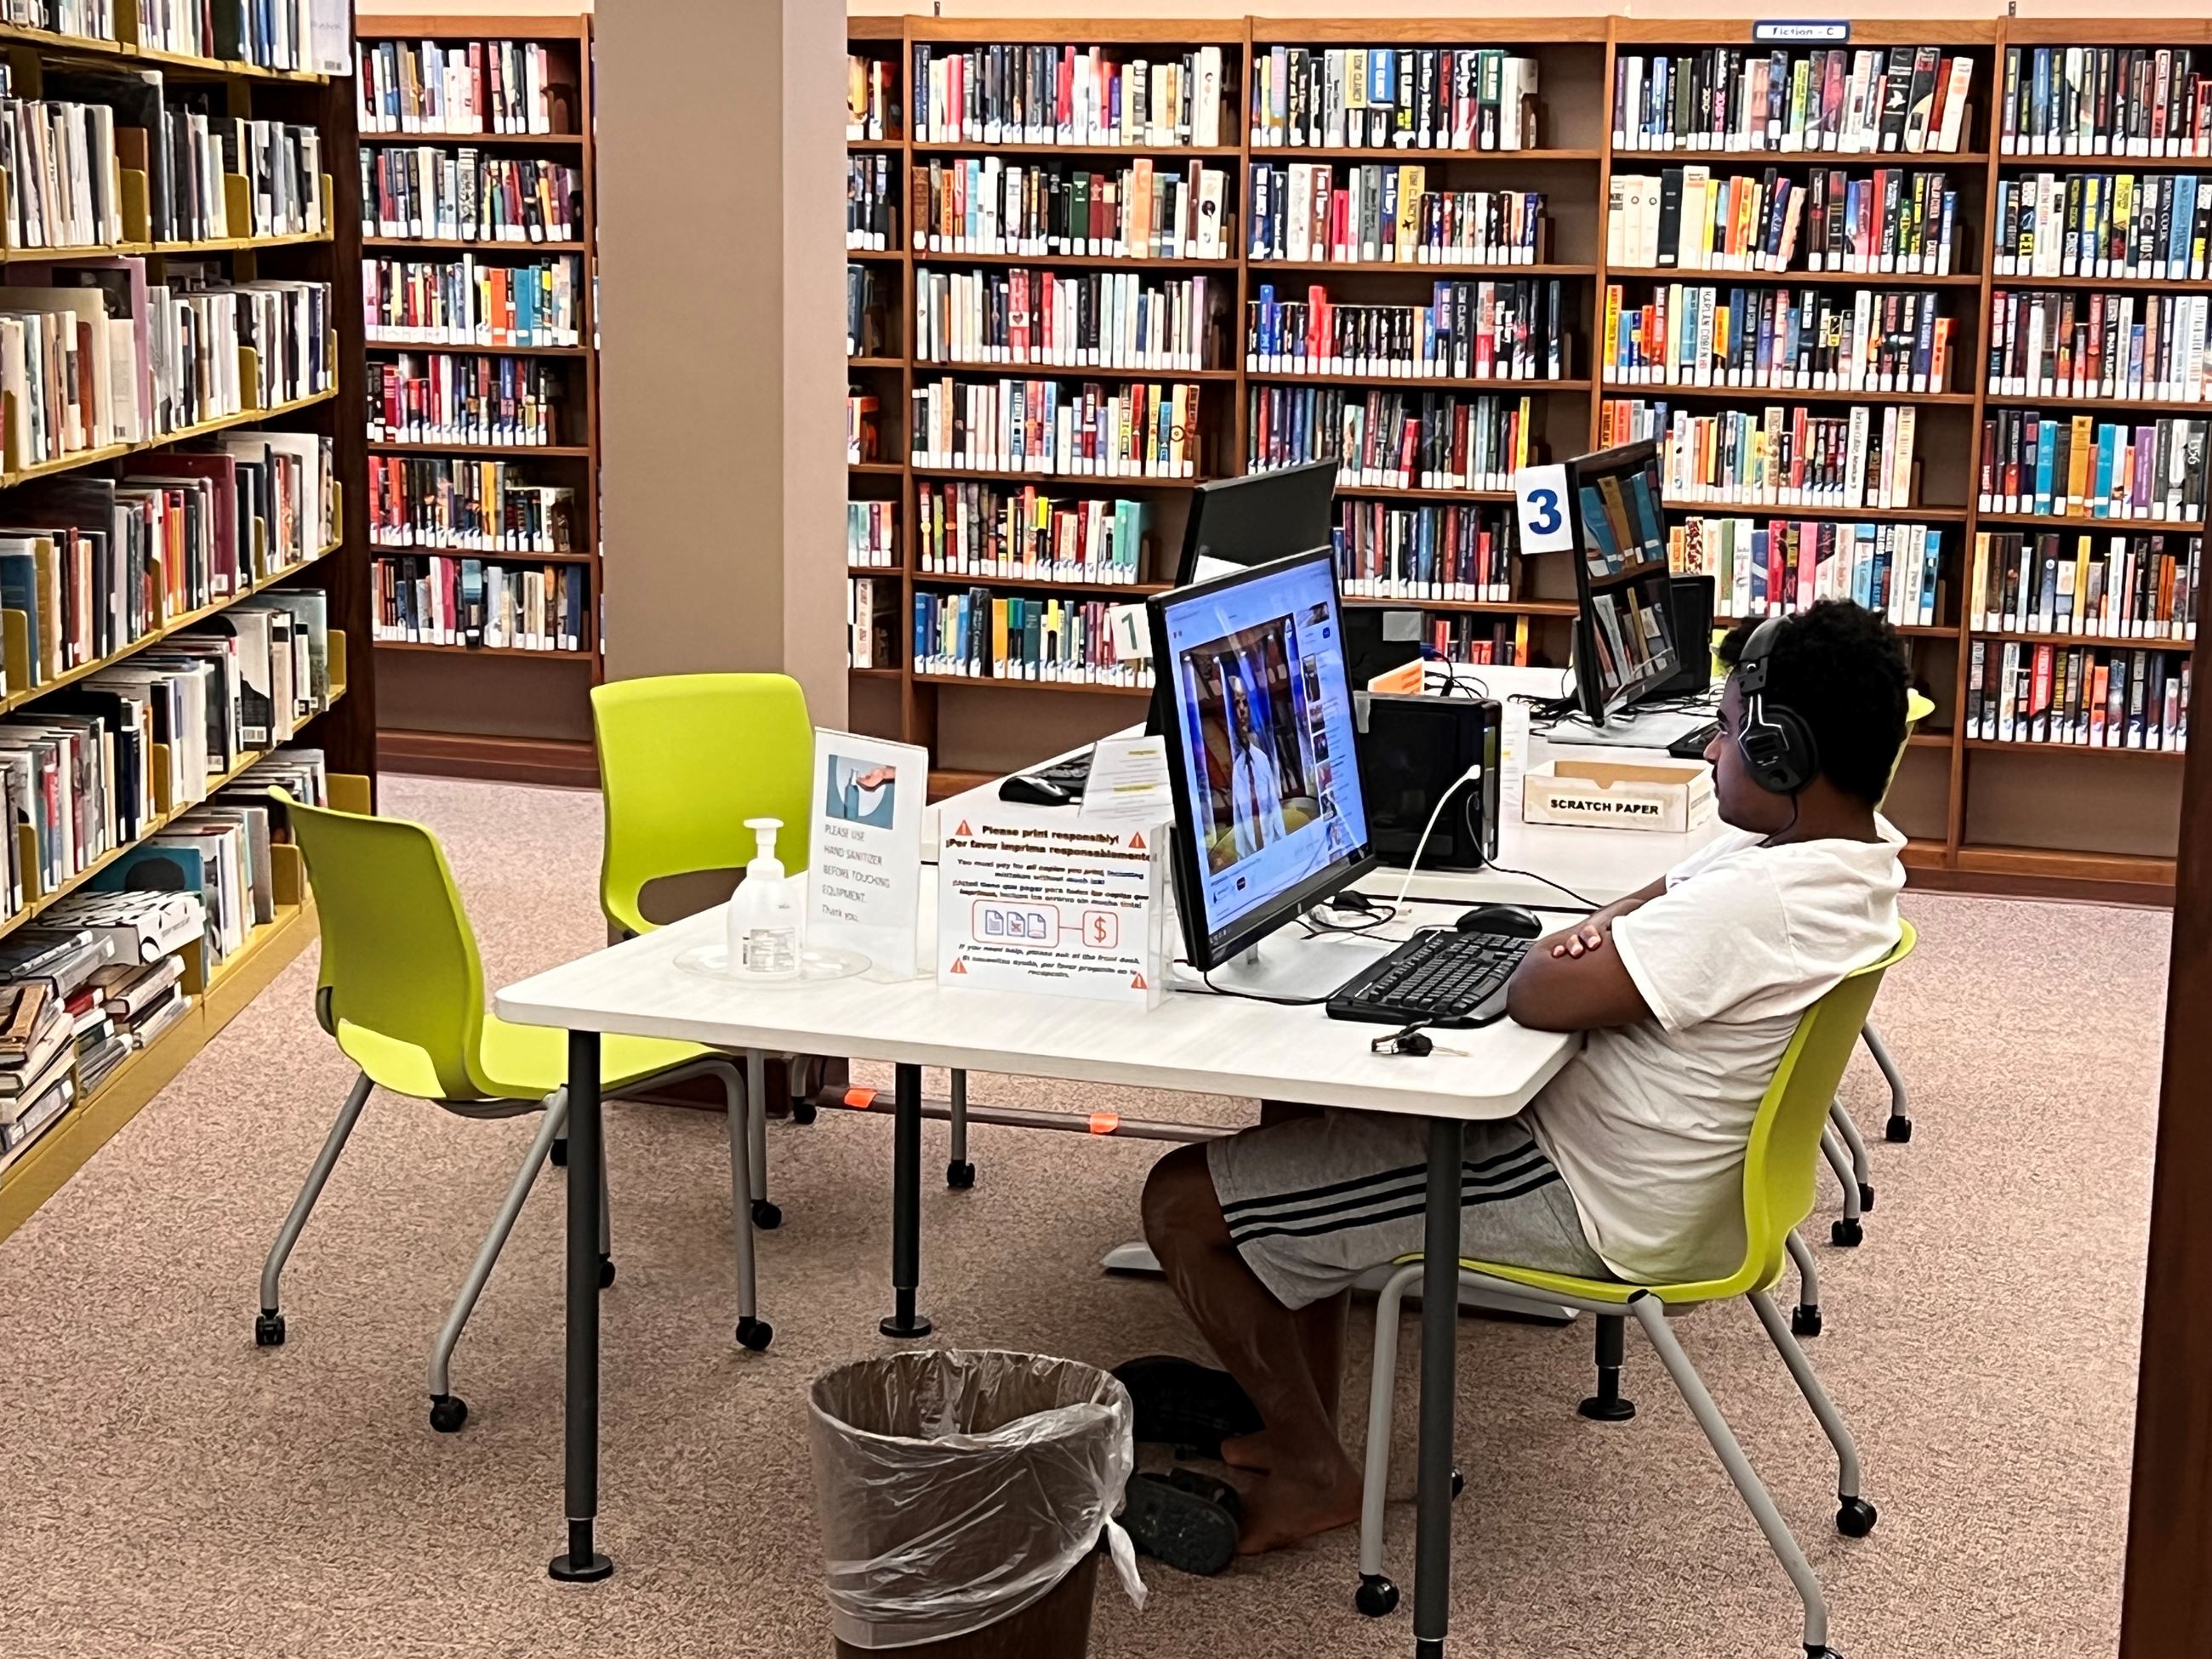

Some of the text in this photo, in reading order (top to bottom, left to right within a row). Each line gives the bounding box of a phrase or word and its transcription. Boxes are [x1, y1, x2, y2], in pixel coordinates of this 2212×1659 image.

[1773, 27, 1812, 36] Fiction
[1353, 73, 1363, 102] CLANCY
[2159, 180, 2172, 242] ROBIN COOK
[1700, 291, 1712, 358] HARLAN COBEN
[1921, 294, 1934, 350] HARLAN COBEN
[2187, 440, 2202, 465] 1356
[1527, 488, 1562, 534] 3
[1121, 612, 1137, 650] 1
[1550, 799, 1659, 815] SCRATCH PAPER
[825, 824, 864, 841] PLEASE USE
[982, 825, 1120, 845] Please print responsibly!
[824, 845, 882, 866] HAND SANITIZER
[970, 840, 998, 850] favor
[1001, 841, 1046, 853] imprima
[824, 864, 890, 888] BEFORE TOUCHING
